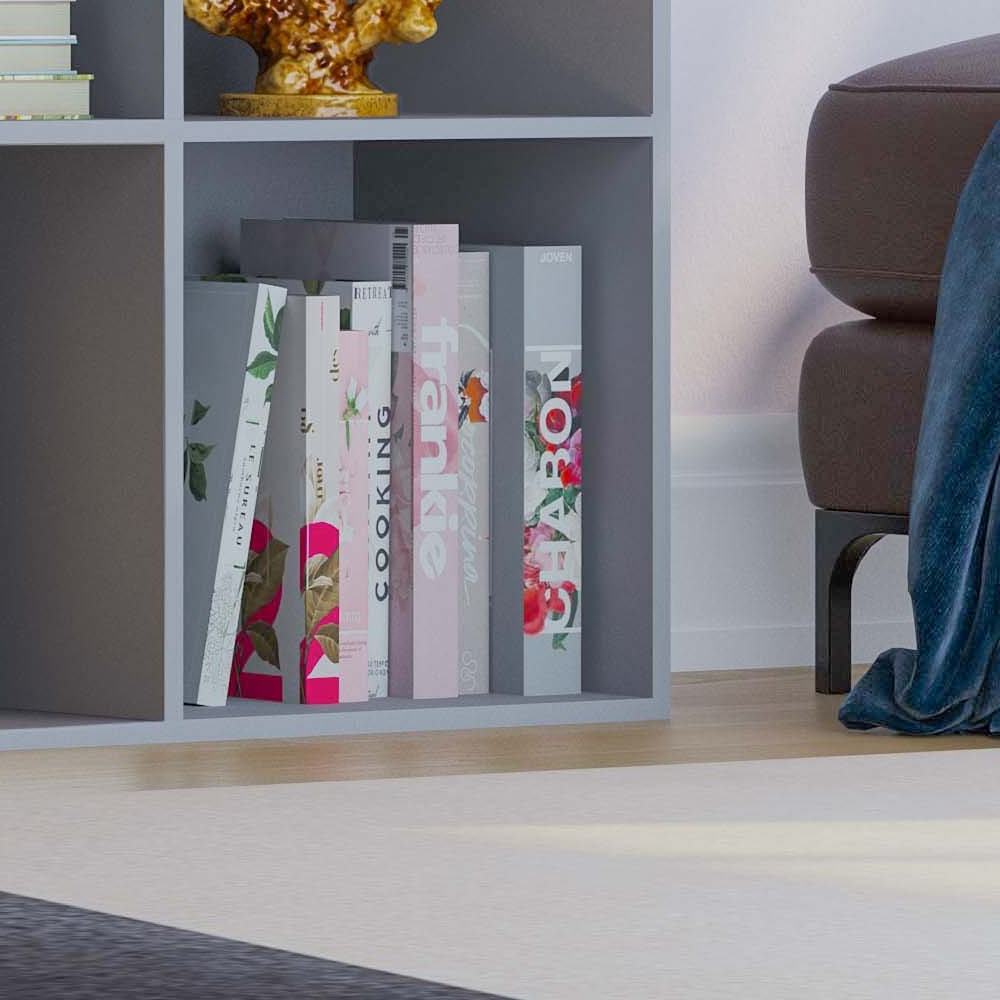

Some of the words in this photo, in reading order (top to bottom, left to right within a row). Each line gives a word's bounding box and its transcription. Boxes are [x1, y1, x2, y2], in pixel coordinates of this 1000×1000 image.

[375, 406, 391, 602] COOKING
[419, 317, 458, 581] frankie
[539, 351, 573, 632] CHABON
